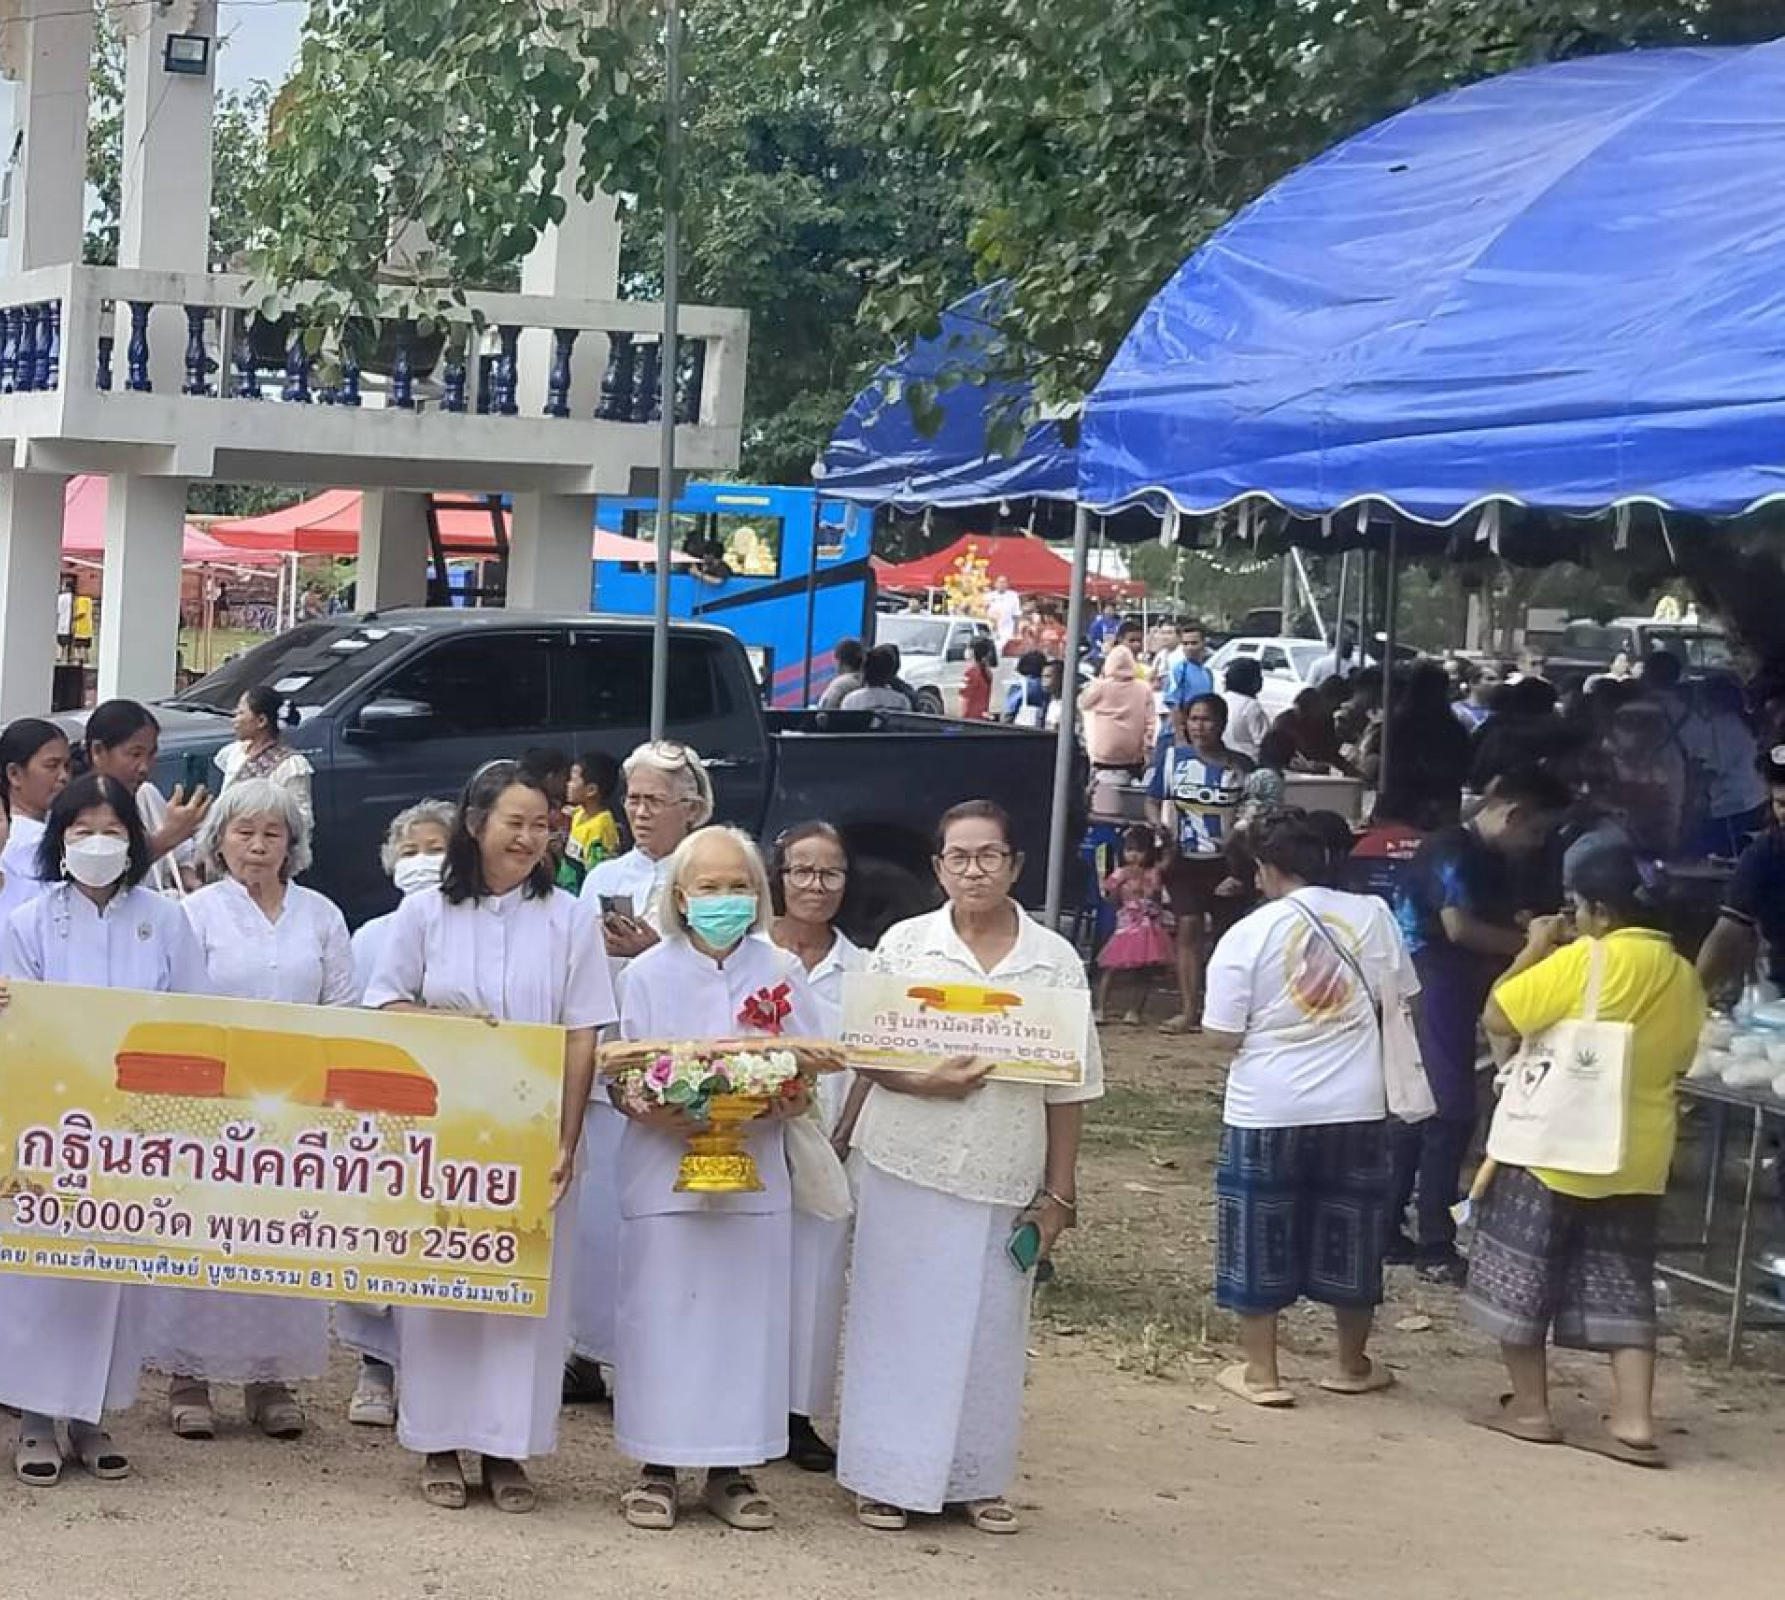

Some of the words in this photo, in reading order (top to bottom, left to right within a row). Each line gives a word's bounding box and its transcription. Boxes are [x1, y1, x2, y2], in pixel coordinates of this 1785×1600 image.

[23, 1113, 518, 1206] กฐินสามัคคีทั่วไทย
[208, 1209, 408, 1254] พุทธศักราช
[423, 1229, 516, 1264] 2568
[35, 1247, 199, 1280] คณะศิษยานุศิษย์
[208, 1264, 301, 1286] บูชาธรรม
[310, 1270, 333, 1288] 81
[343, 1269, 359, 1291] ปี
[366, 1277, 534, 1305] หลวงพ่อธัมมชโย
